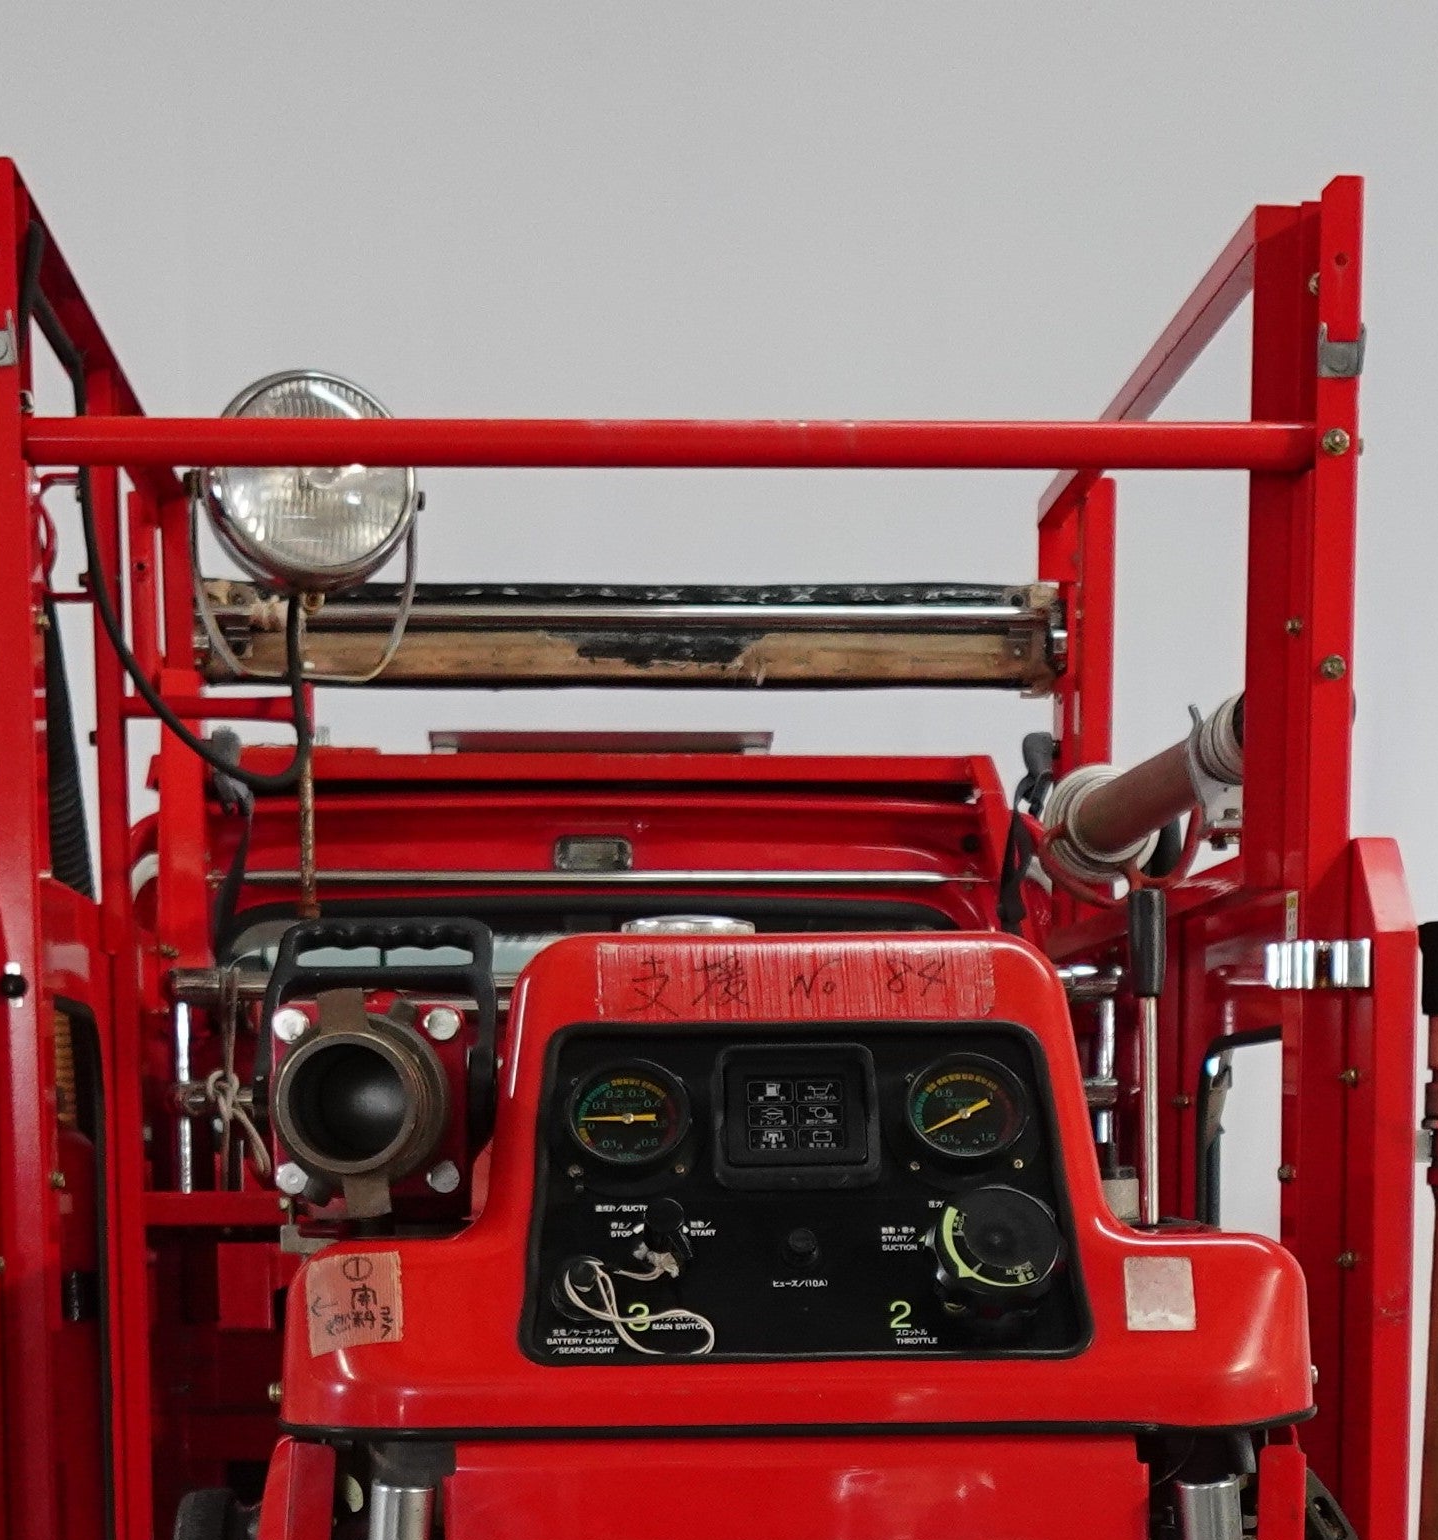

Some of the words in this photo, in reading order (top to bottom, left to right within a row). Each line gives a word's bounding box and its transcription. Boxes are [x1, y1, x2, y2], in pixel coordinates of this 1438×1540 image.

[610, 1230, 633, 1238] STOP
[690, 1228, 717, 1237] START
[881, 1243, 919, 1251] SUCTION
[627, 1303, 651, 1332] 3
[889, 1300, 912, 1329] 2
[652, 1323, 673, 1331] MAIN
[546, 1337, 583, 1346] BATTERY
[585, 1337, 619, 1345] CHARGE
[895, 1336, 939, 1345] THROTTLE
